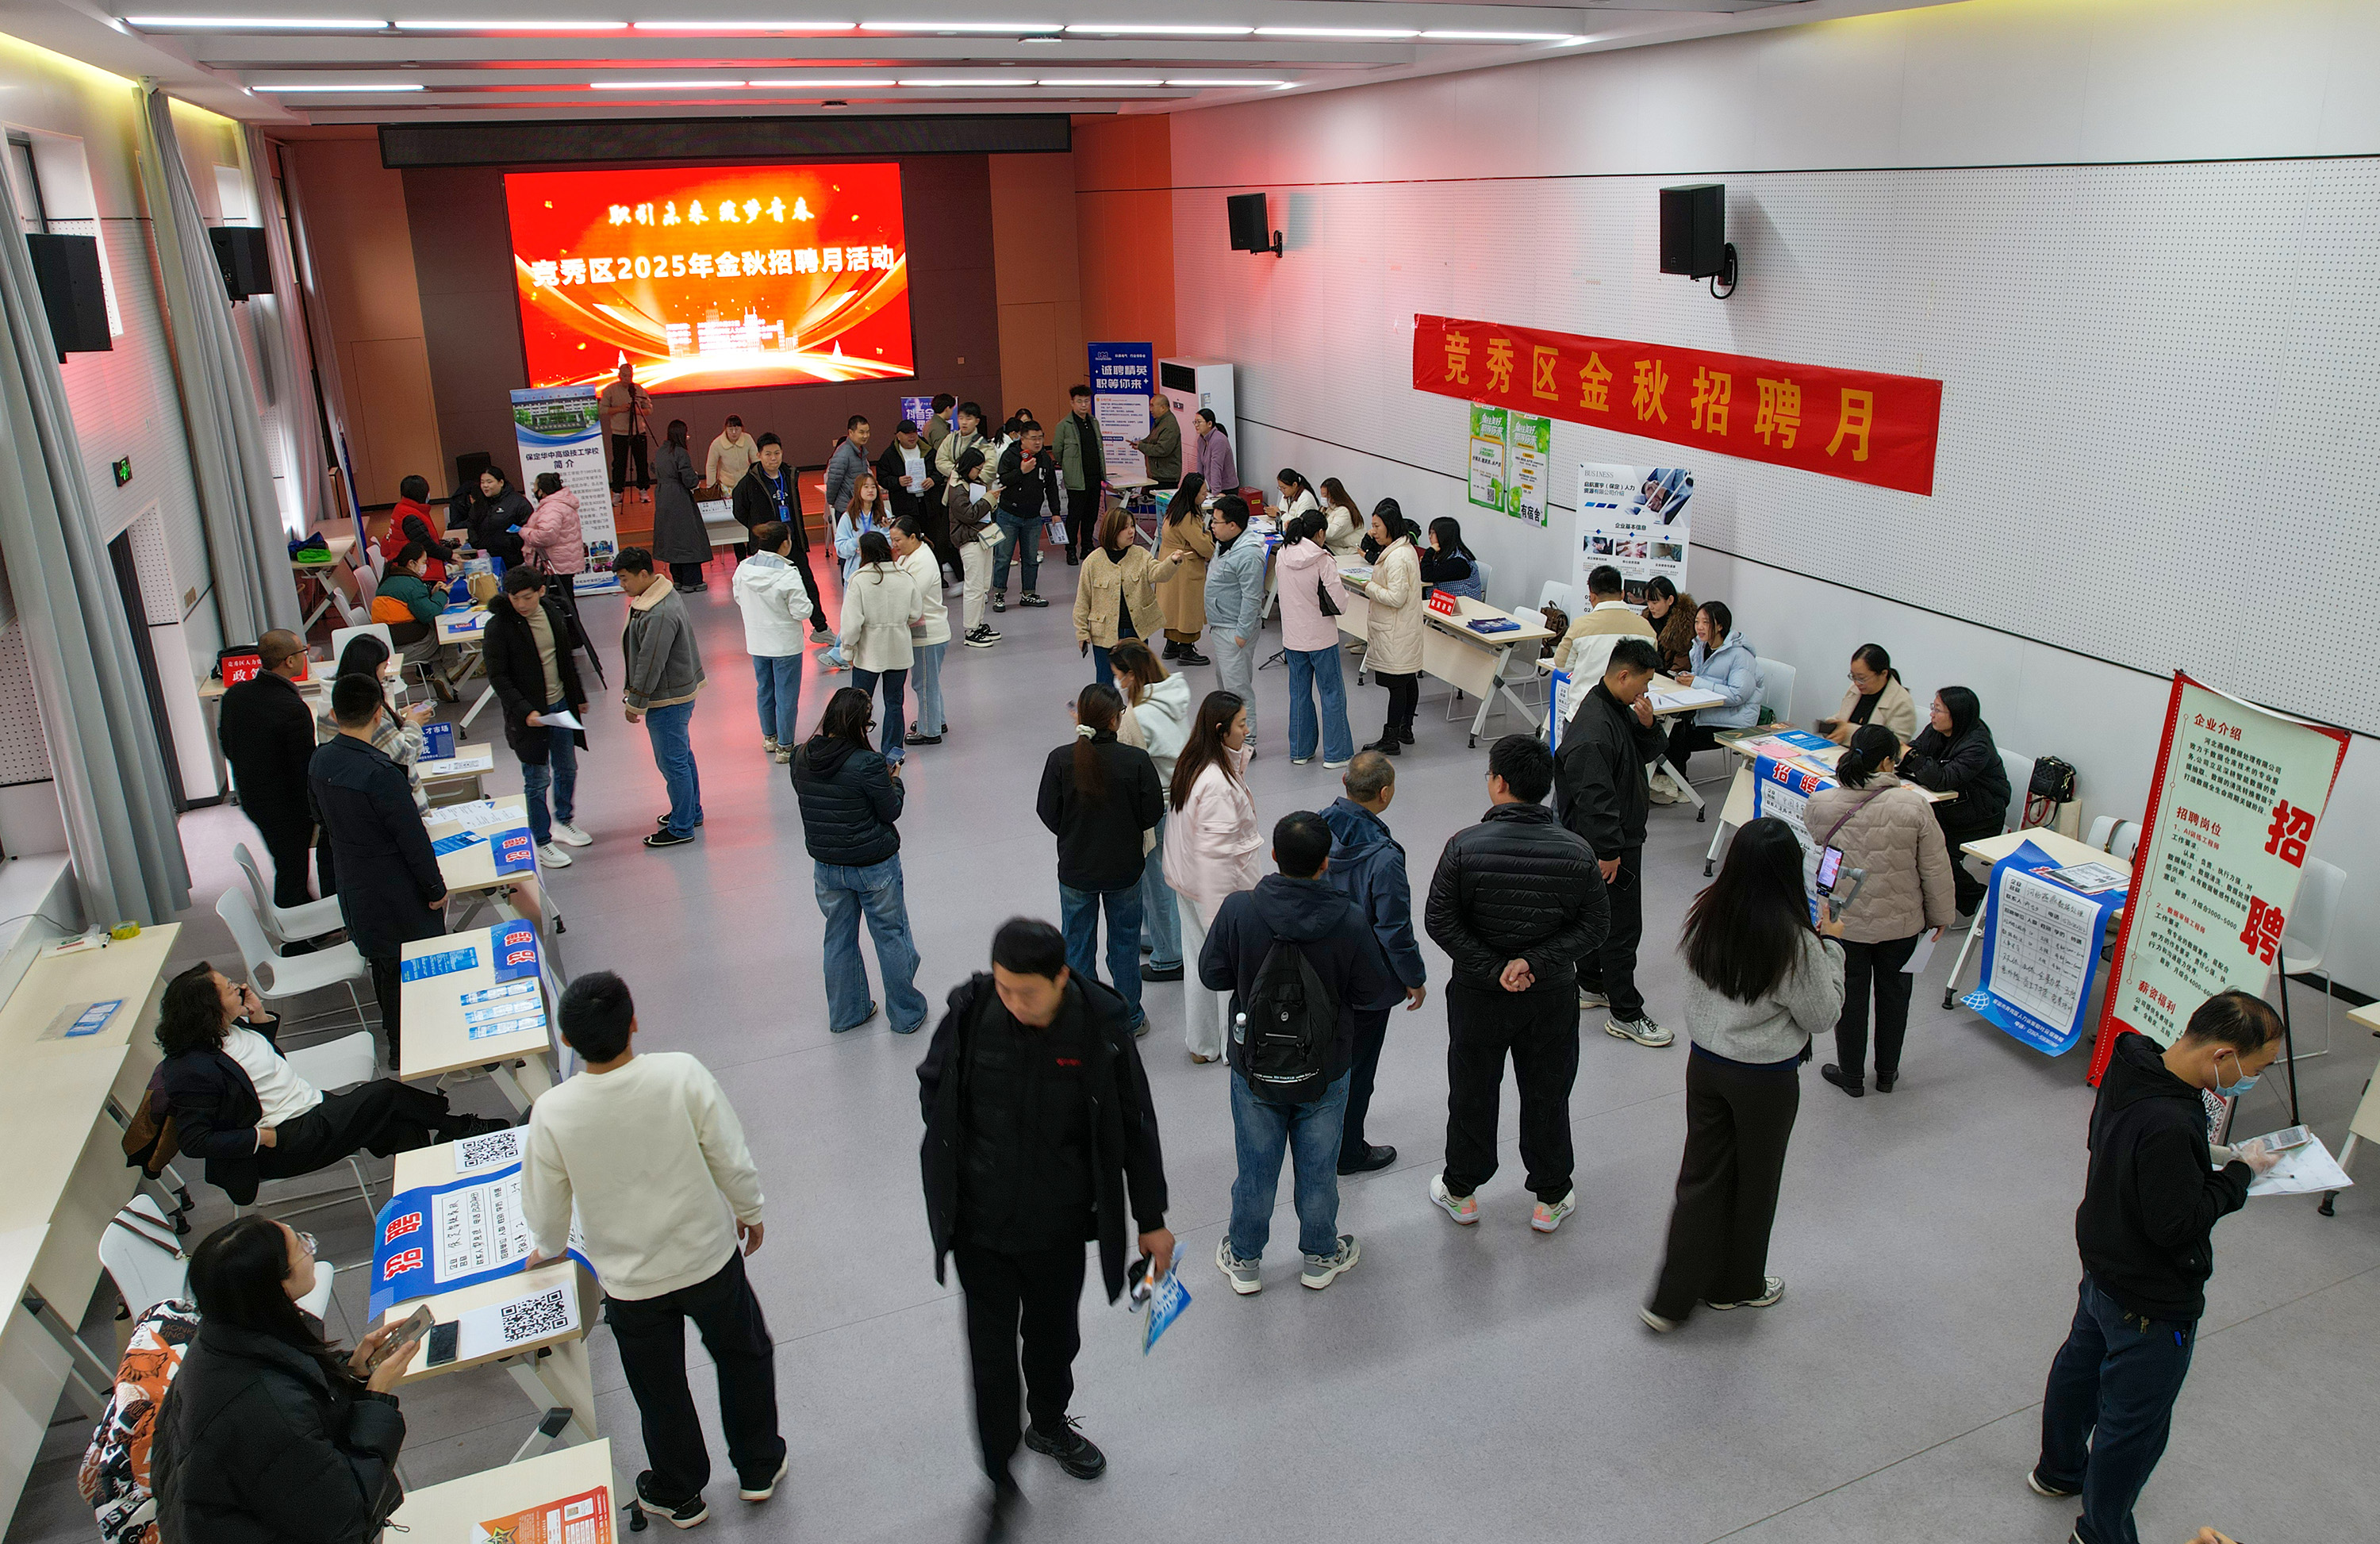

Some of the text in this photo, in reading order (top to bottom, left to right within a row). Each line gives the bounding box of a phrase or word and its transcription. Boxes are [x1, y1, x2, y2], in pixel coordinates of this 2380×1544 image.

[531, 244, 895, 288] 竞秀区2025年金秋招聘月活动
[1101, 365, 1147, 375] 诚聘精英
[1096, 378, 1142, 389] 职等你来
[1444, 330, 1875, 463] 竞秀区金秋招聘月
[526, 447, 600, 461] 保定华中高级技工学校
[554, 459, 574, 469] 简介
[1584, 487, 1625, 496] 资源有限公司介绍
[1521, 504, 1541, 523] 有宿舍
[1615, 522, 1647, 531] 企业基本信息
[422, 724, 449, 736] 才市场
[2194, 713, 2242, 741] 企业介绍
[1772, 762, 1821, 794] 招聘
[2176, 805, 2222, 837] 招聘岗位
[505, 931, 536, 966] 招聘
[2138, 980, 2176, 1015] 薪资福利
[473, 1213, 481, 1225] 电话
[383, 1211, 423, 1282] 招聘
[450, 1258, 458, 1270] 企业
[459, 1255, 468, 1268] 名称
[475, 1249, 484, 1266] 联系人
